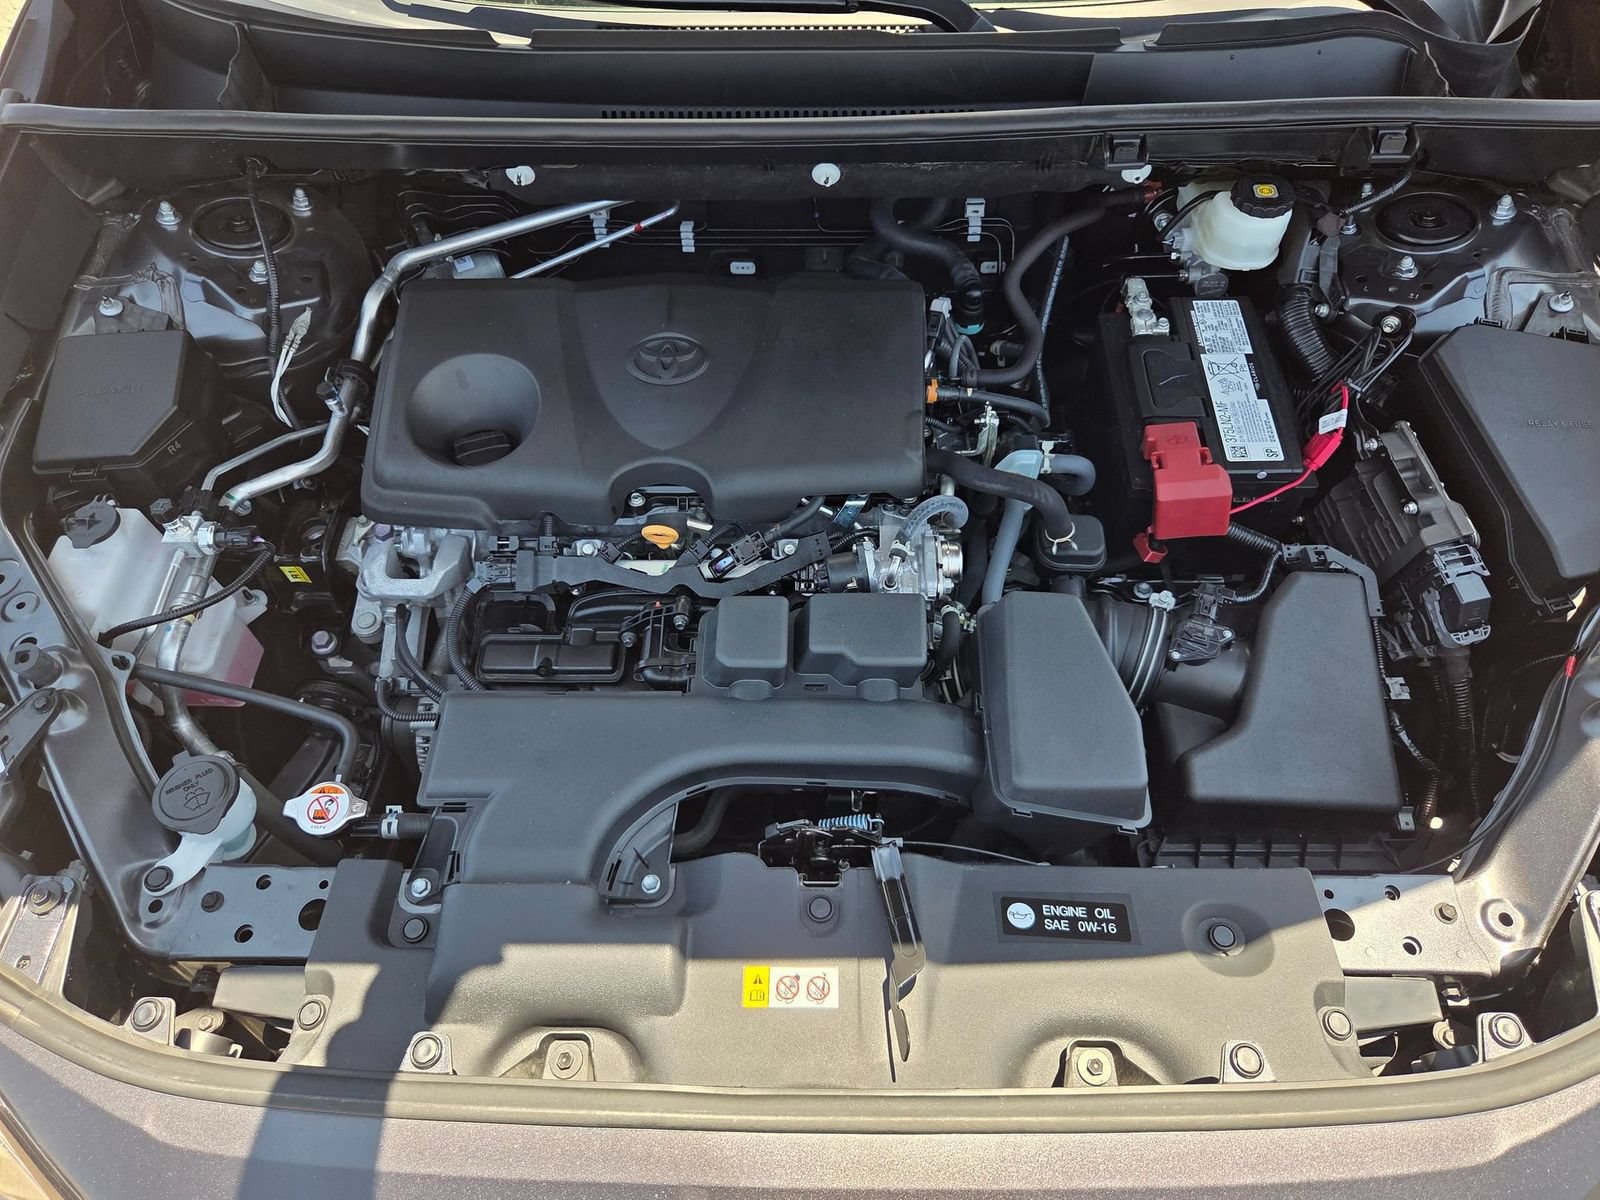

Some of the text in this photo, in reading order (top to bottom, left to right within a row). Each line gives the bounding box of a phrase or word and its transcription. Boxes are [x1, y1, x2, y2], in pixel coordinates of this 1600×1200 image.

[1240, 363, 1248, 373] Pb
[1249, 362, 1258, 383] CLARIOS
[1215, 400, 1237, 443] 375LN2-MF
[167, 440, 181, 455] R4
[1265, 448, 1278, 457] SP
[182, 780, 199, 792] ONLY
[1042, 904, 1115, 919] ENGINE OIL
[1044, 919, 1117, 934] SAE 0W-16
